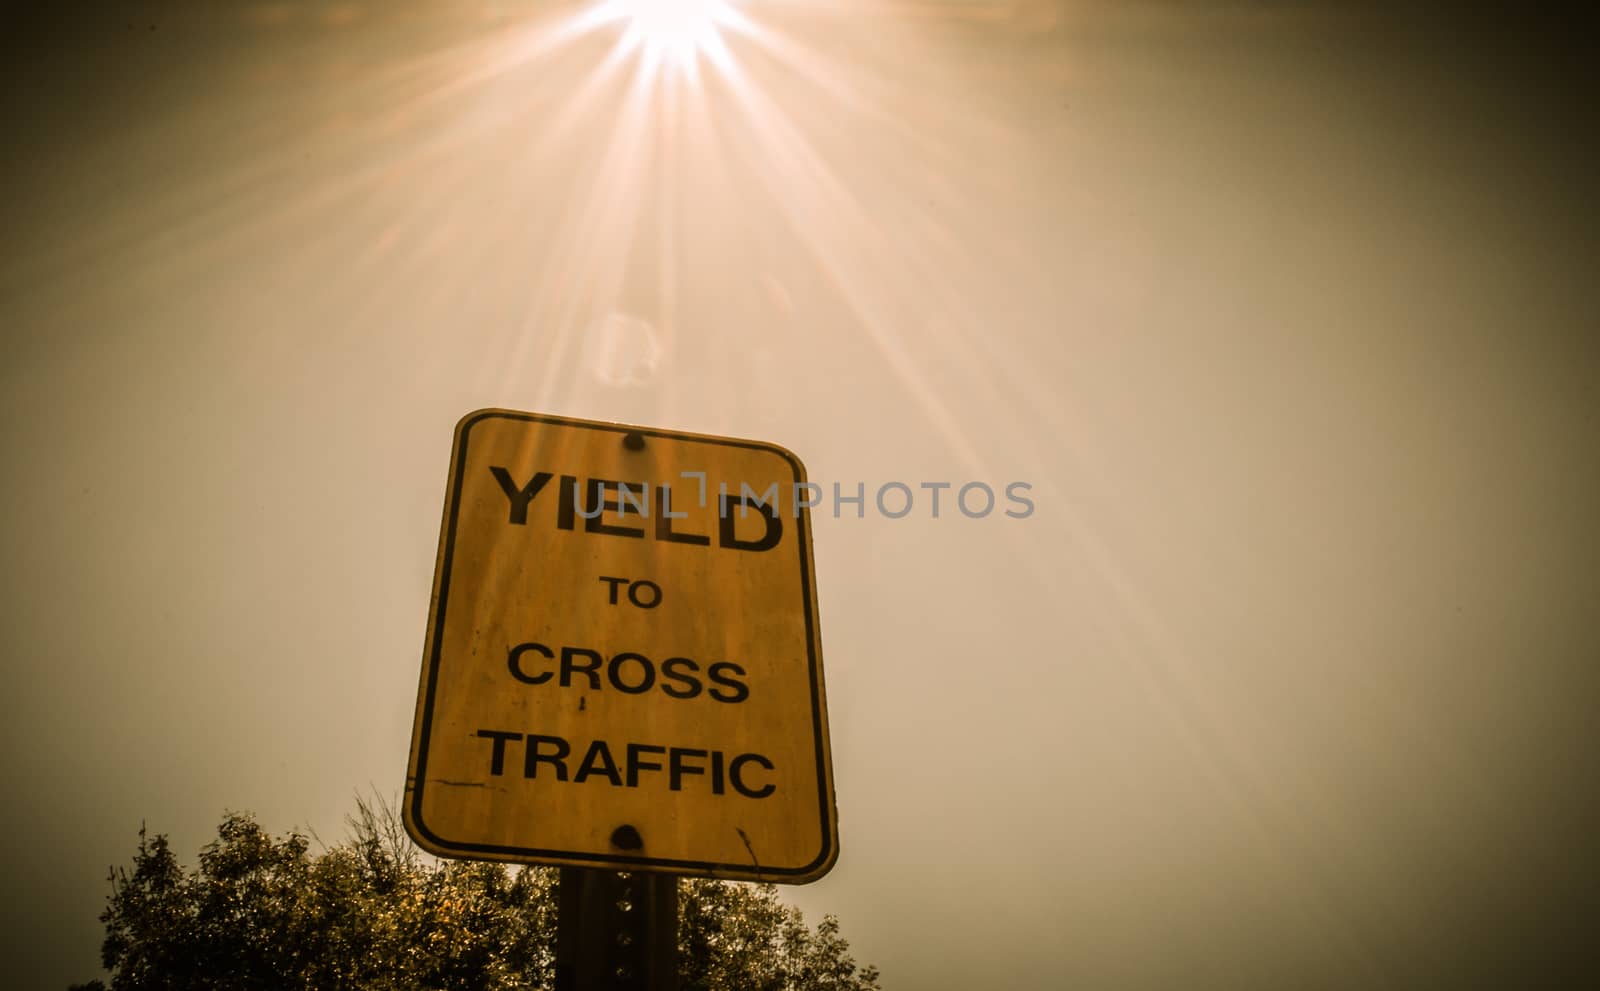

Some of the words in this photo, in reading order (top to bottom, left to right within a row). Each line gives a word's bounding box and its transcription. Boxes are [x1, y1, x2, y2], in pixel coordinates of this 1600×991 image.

[489, 466, 784, 553] YIELD
[598, 576, 662, 608] TO
[507, 642, 750, 704] CROSS
[477, 729, 777, 799] TRAFFIC
